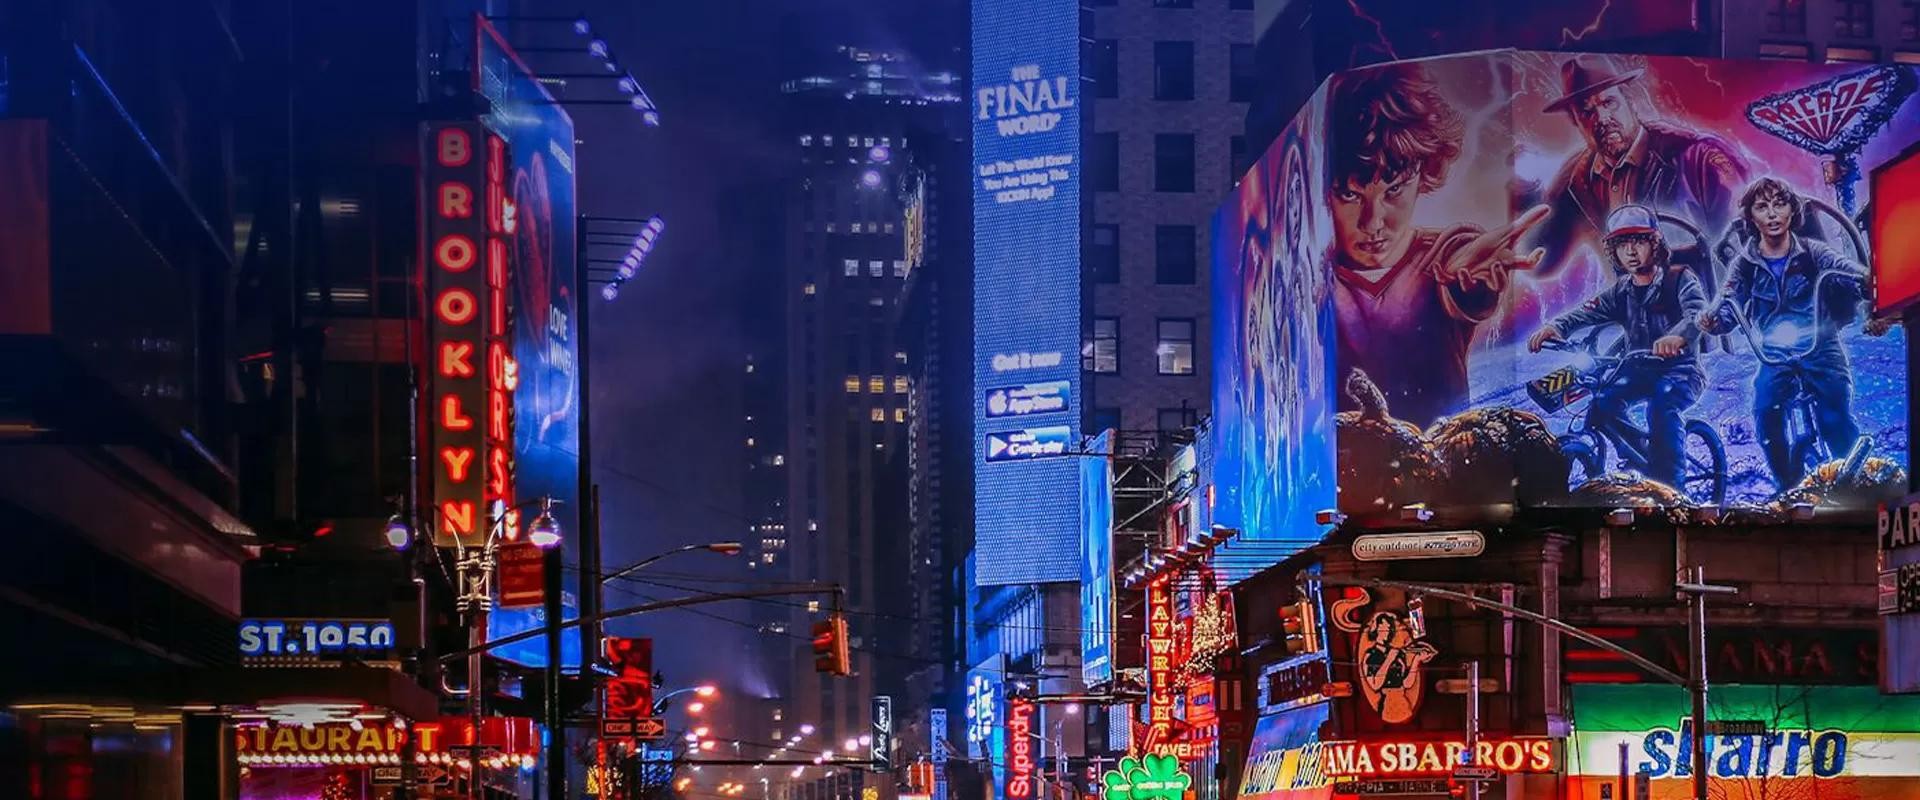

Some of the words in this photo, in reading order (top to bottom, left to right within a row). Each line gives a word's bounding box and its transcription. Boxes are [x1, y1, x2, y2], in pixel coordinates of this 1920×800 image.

[978, 77, 1074, 120] FINAL
[1753, 73, 1886, 125] ARCADE
[434, 127, 479, 534] BROOKLYN
[1010, 699, 1037, 797] Superdry
